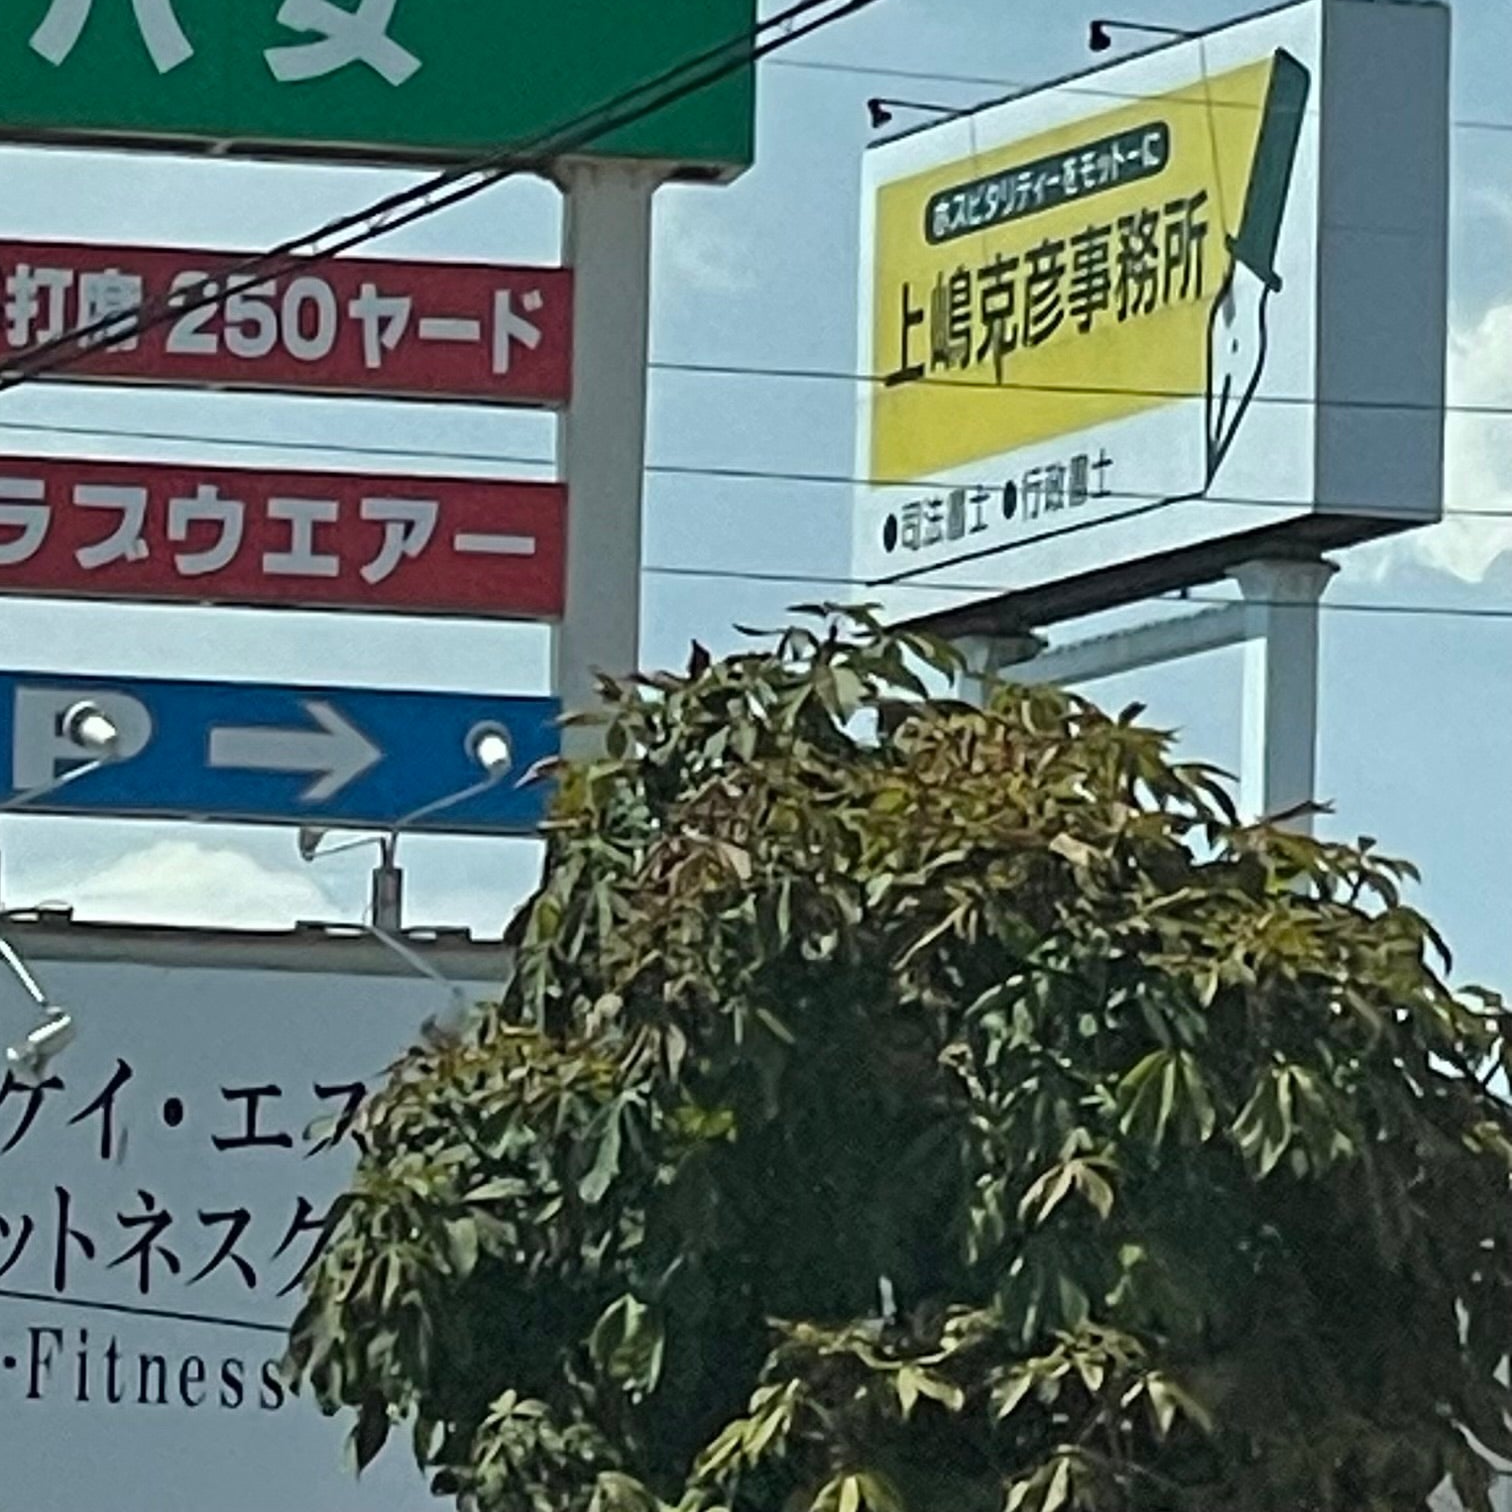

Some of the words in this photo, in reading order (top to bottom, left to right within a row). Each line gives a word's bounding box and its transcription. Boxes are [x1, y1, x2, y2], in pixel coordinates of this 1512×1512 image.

[165, 270, 543, 375] 250ヤード
[884, 189, 1209, 388] 上嶋克彦事務所
[11, 685, 154, 791] P
